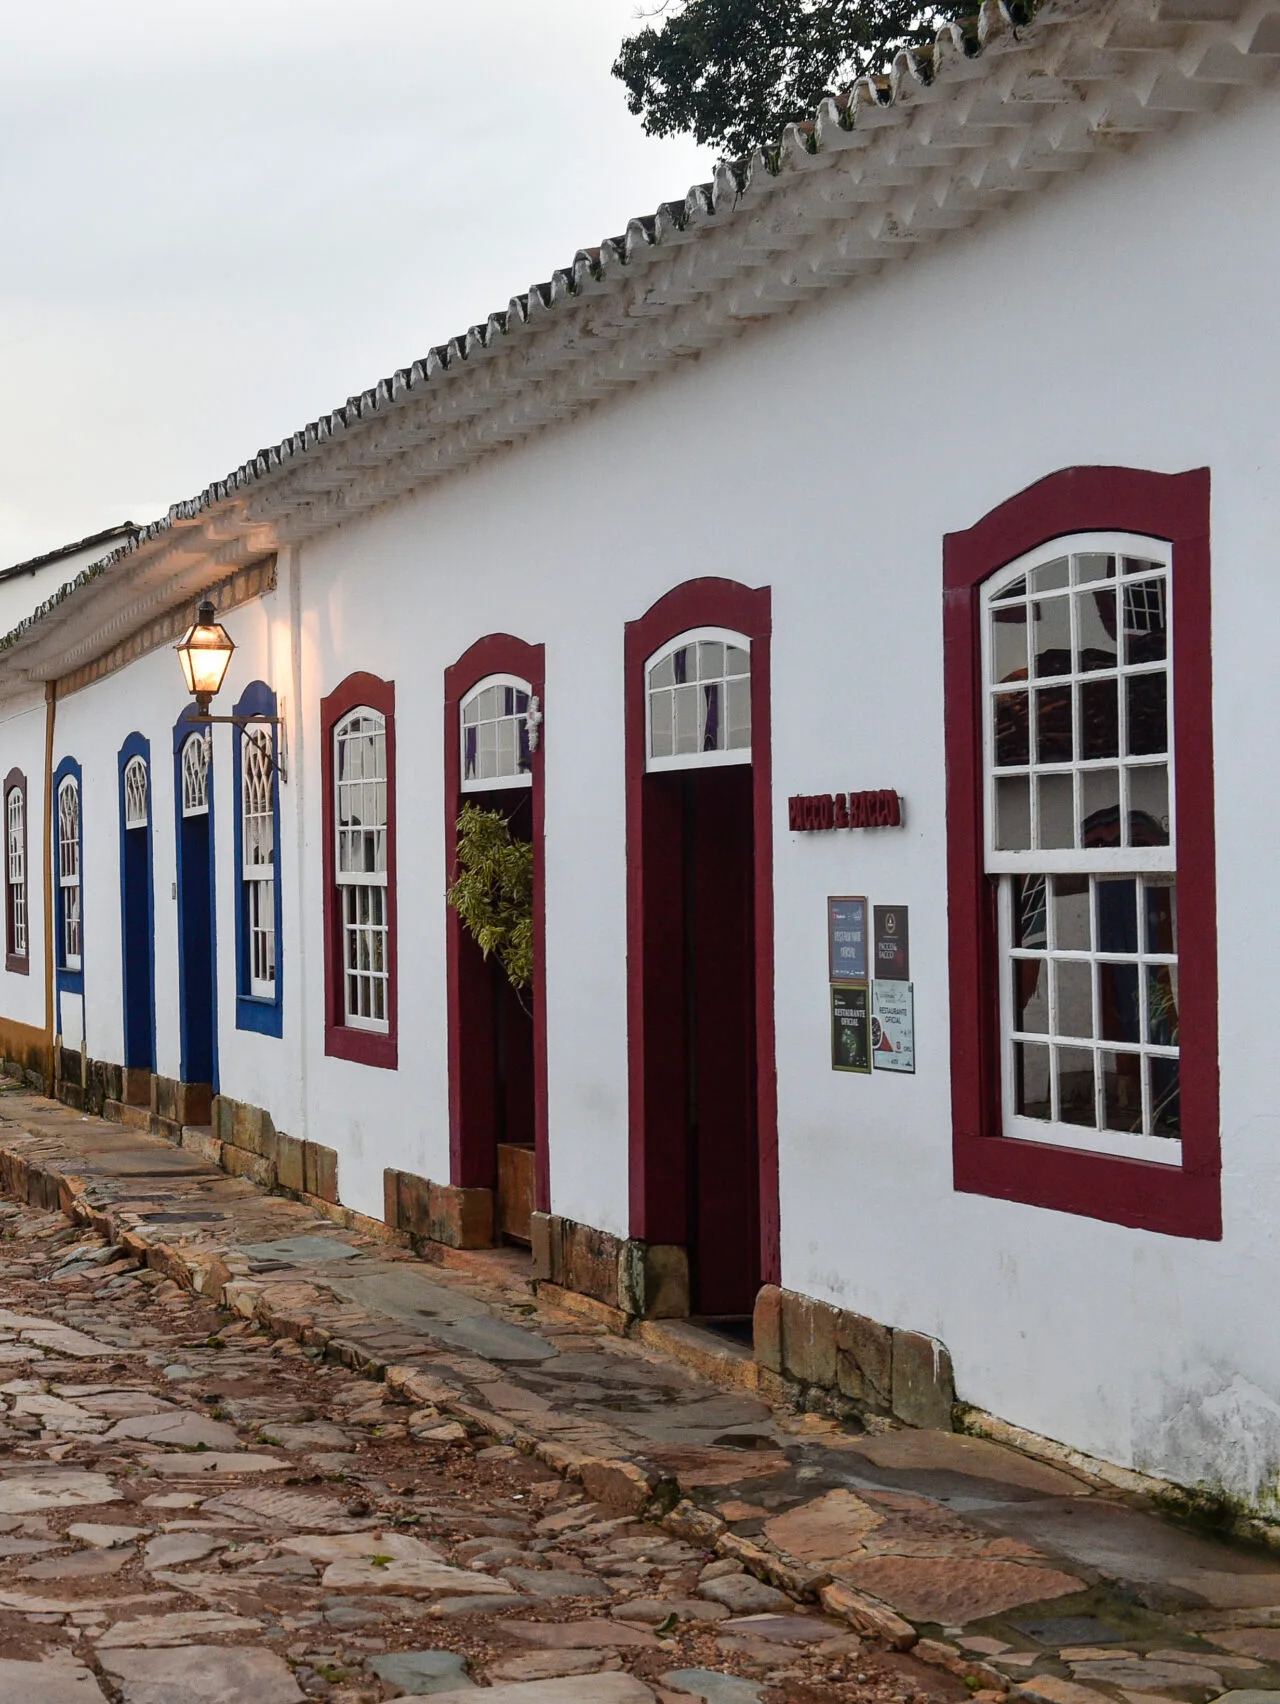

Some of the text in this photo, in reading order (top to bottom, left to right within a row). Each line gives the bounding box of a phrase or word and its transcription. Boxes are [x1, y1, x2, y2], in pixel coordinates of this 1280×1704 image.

[788, 789, 900, 831] PACCO & BACCO
[834, 1008, 866, 1018] RESTAURANTE
[879, 1007, 908, 1016] RESTAURANTE
[841, 1017, 859, 1026] OFICIAL
[885, 1015, 901, 1024] OFICIAL
